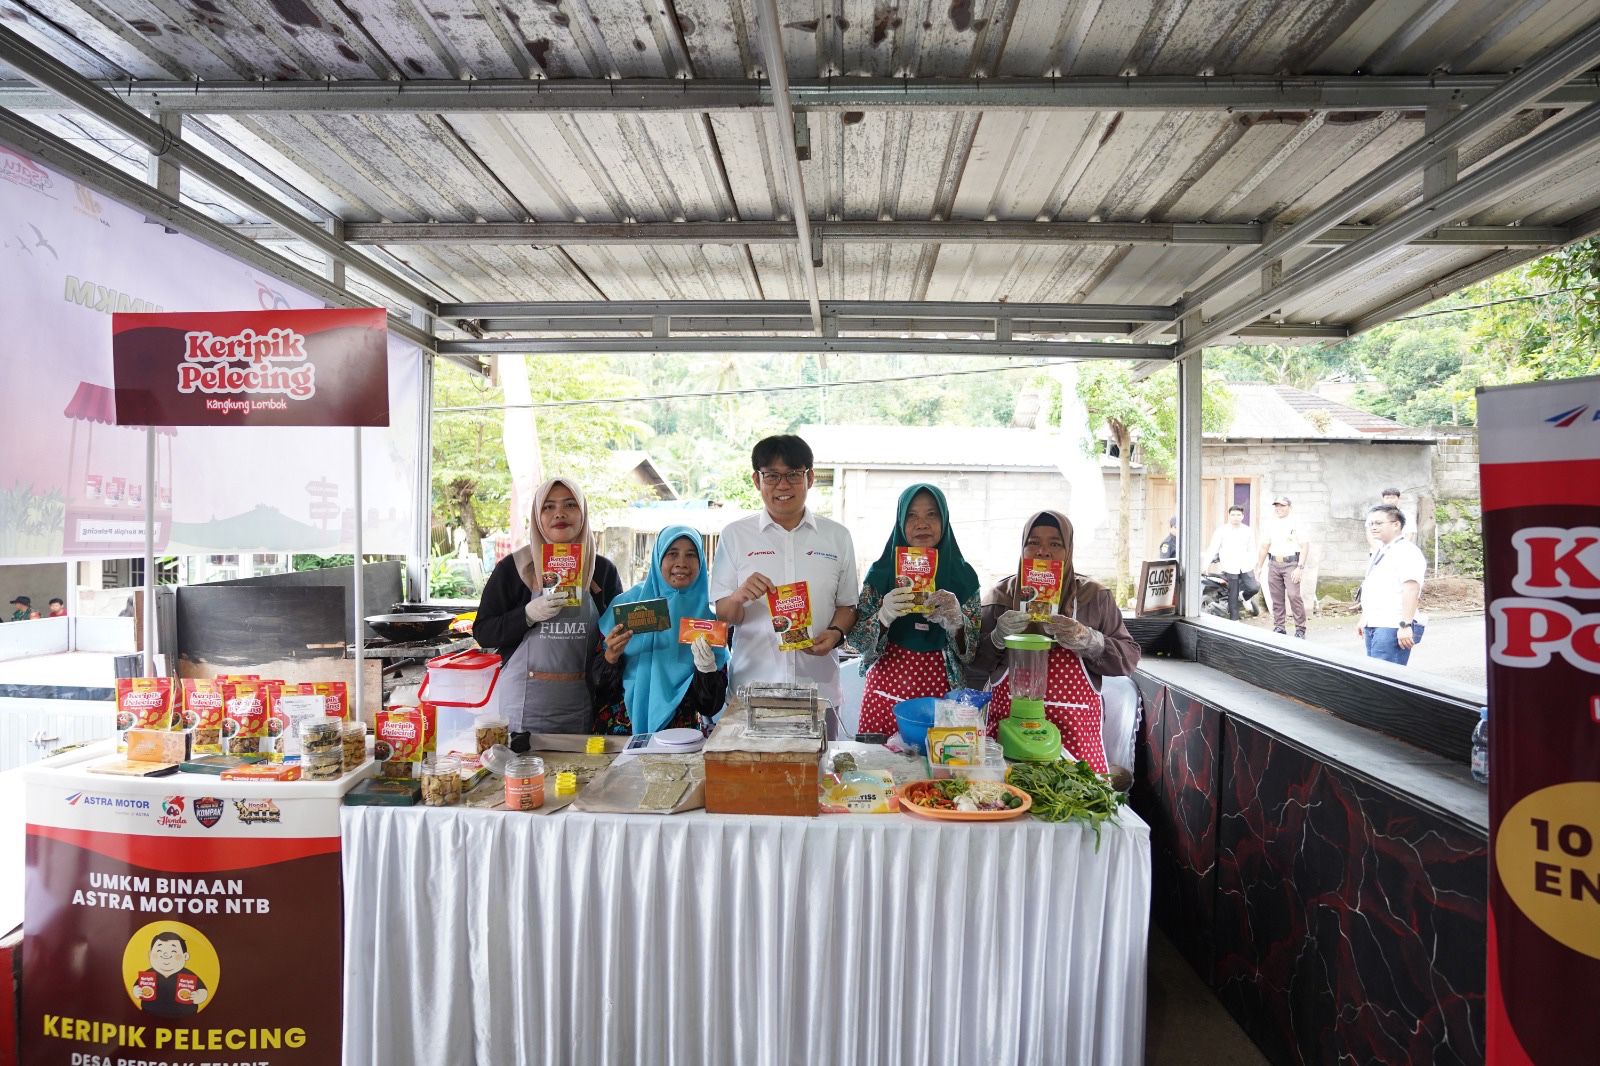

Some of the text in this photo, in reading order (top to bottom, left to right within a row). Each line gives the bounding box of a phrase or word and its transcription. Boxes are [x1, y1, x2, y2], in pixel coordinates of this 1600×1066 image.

[186, 329, 306, 363] Keripik
[179, 363, 314, 399] Pelecing
[206, 399, 287, 413] Kangkung Lombok
[1149, 569, 1174, 585] CLOSE
[540, 622, 586, 634] FILMA
[84, 797, 150, 809] ASTRA MOTOR
[196, 808, 221, 817] KOMPAK
[157, 816, 187, 825] Honda
[90, 872, 243, 895] UMKM BINAAN
[72, 889, 270, 914] ASTRA MOTOR NTB
[43, 1014, 307, 1050] KERIPIK PELECING
[71, 1053, 112, 1066] DESA
